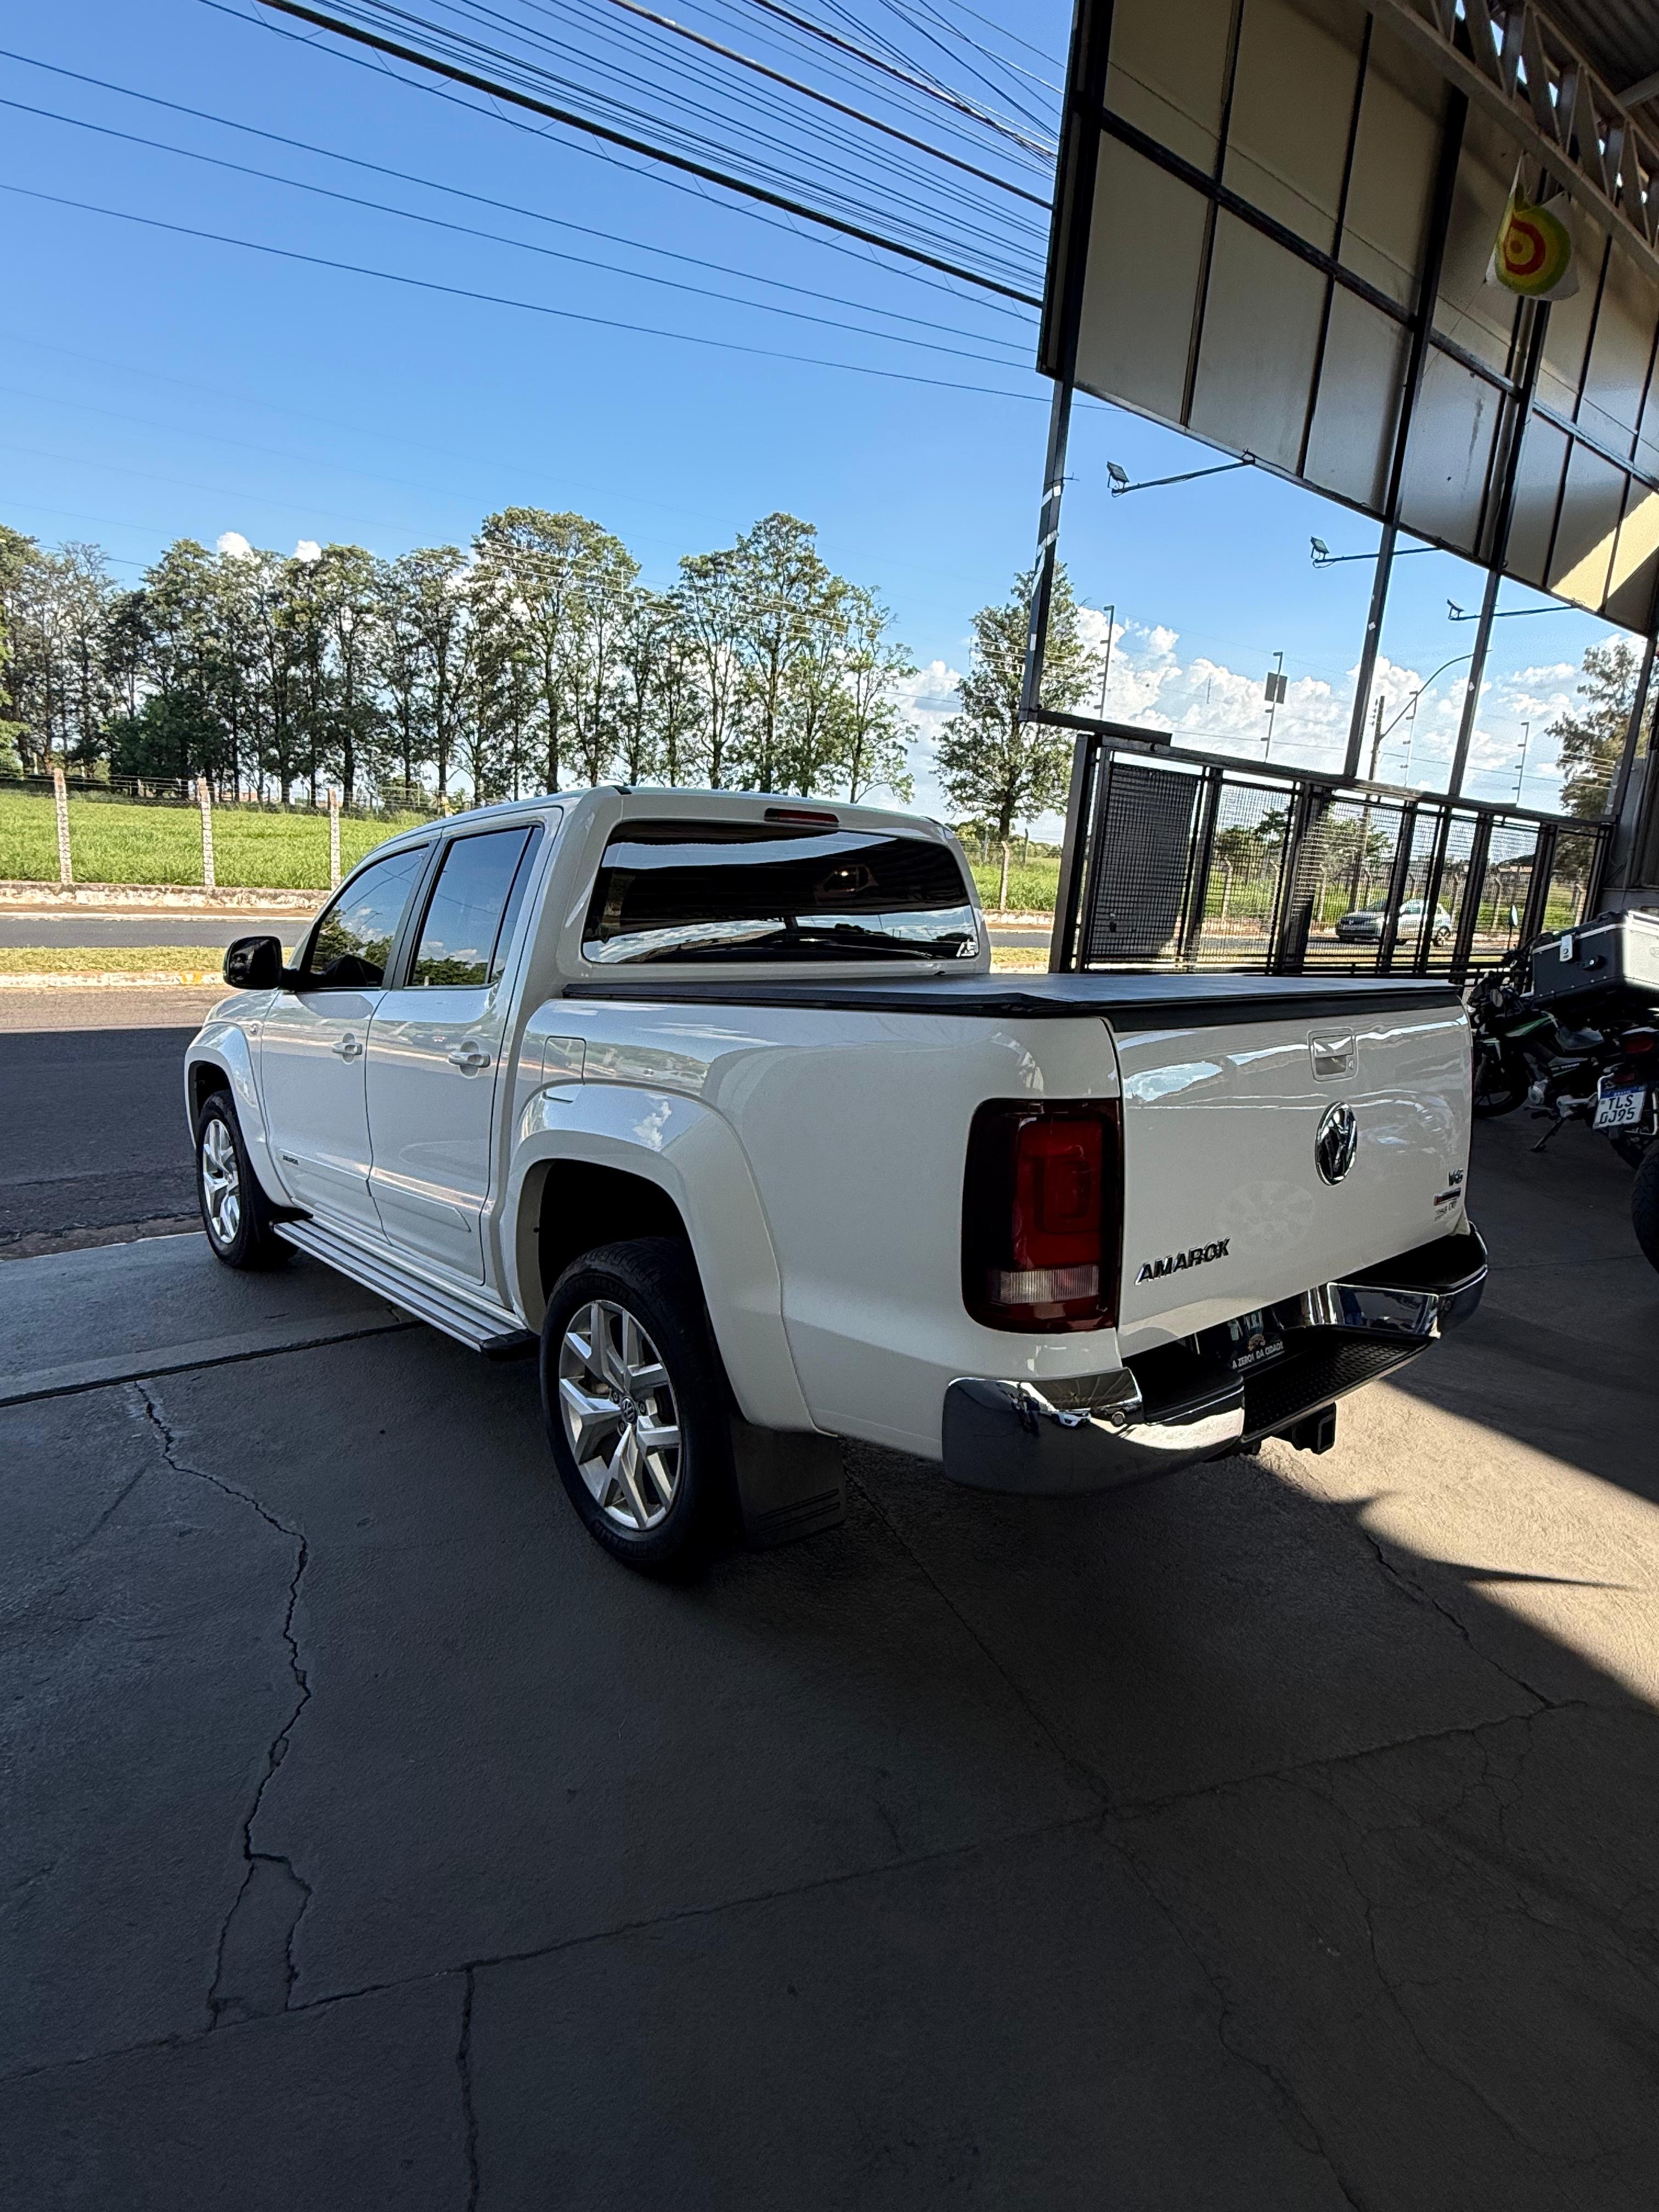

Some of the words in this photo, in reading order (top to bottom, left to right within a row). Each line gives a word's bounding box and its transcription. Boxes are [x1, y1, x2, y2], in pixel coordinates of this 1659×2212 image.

[1609, 1094, 1634, 1110] TLS
[1134, 1236, 1231, 1286] AMAROK
[1232, 1359, 1238, 1369] A
[1256, 1348, 1265, 1359] DA
